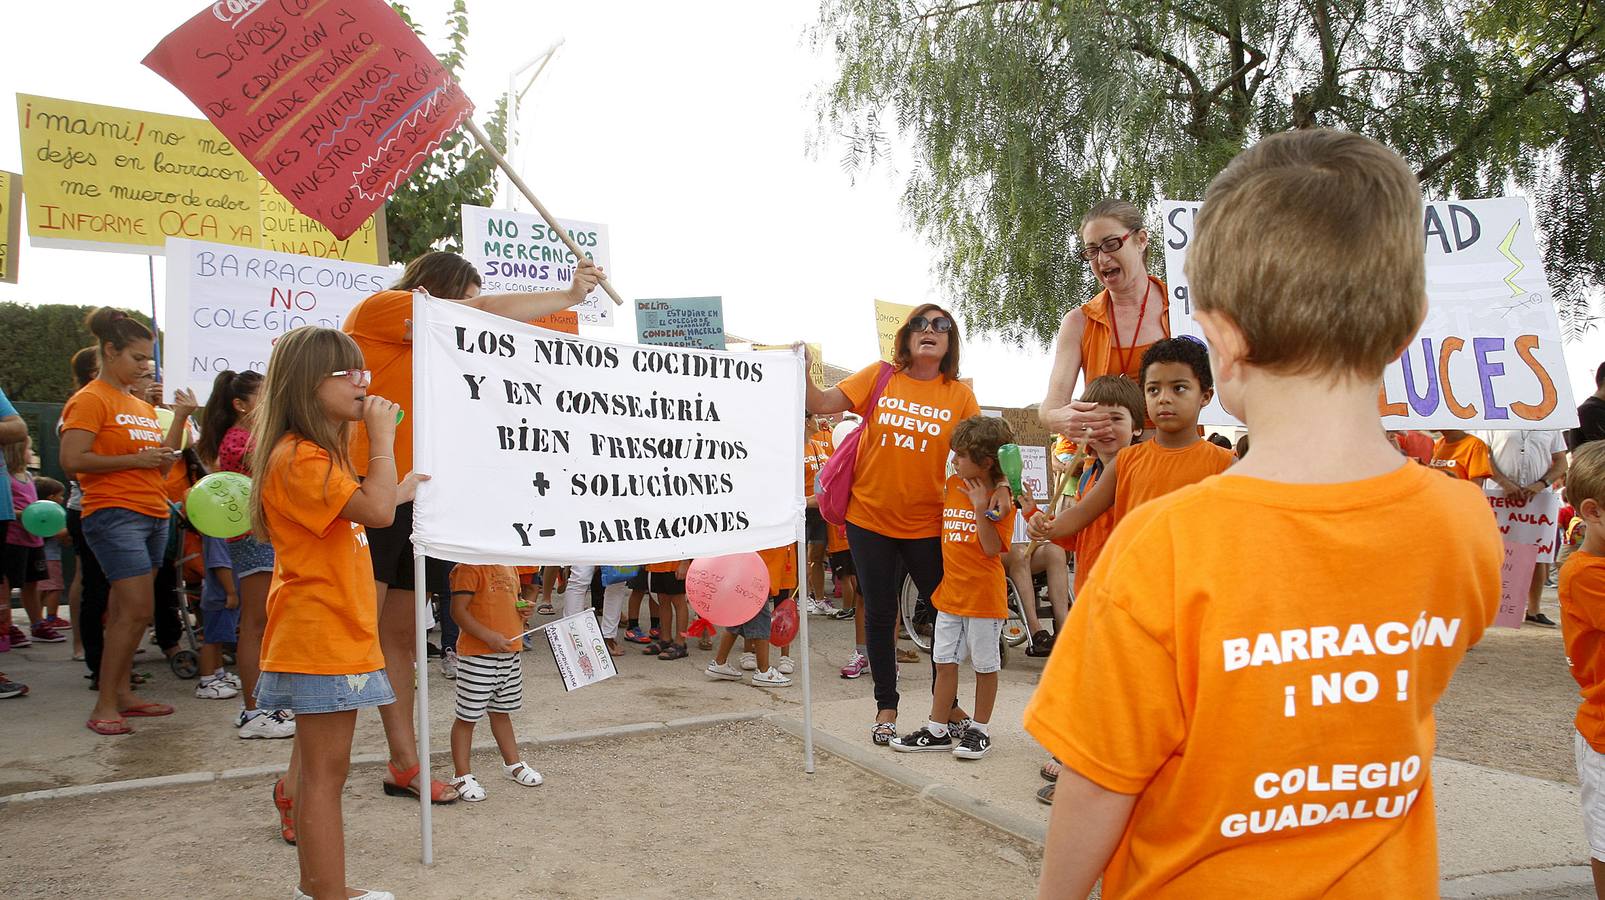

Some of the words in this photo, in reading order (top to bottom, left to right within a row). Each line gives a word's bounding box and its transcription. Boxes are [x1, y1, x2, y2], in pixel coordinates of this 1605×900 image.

[206, 97, 238, 118] DE
[242, 22, 328, 100] EDUCACIÓN
[336, 8, 357, 35] Y
[238, 89, 308, 149] ALCALDE
[303, 31, 374, 92] PEDÁNEO
[266, 148, 301, 176] LES
[300, 63, 392, 147] INVITAMOS
[393, 47, 412, 62] A
[148, 128, 185, 146] no
[199, 137, 234, 156] me
[36, 139, 98, 170] dejes
[114, 156, 146, 171] en
[153, 151, 249, 183] barracon
[291, 138, 361, 200] NUESTRO
[330, 190, 356, 220] CON
[360, 145, 405, 191] CORTES
[404, 126, 426, 144] DE
[61, 180, 101, 198] me
[109, 184, 182, 204] muero
[181, 188, 202, 207] de
[205, 195, 250, 211] calor
[39, 204, 147, 236] INFORME
[159, 210, 218, 238] OCA
[229, 224, 253, 243] YA
[263, 217, 297, 232] QUE
[488, 218, 519, 239] NO
[196, 251, 385, 293] BARRACONES
[484, 261, 550, 280] SOMOS
[270, 287, 317, 311] NO
[192, 356, 230, 372] NO
[455, 326, 516, 358] LOS
[534, 338, 620, 370] NIÑOS
[632, 348, 764, 383] COCIDITOS
[463, 374, 487, 400] Y
[502, 379, 545, 406] EN
[877, 412, 941, 437] NUEVO
[878, 396, 952, 421] COLEGIO
[497, 417, 571, 454] BIEN
[590, 432, 749, 460] FRESQUITOS
[893, 432, 915, 450] YA
[532, 471, 551, 496] +
[571, 466, 734, 497] SOLUCIONES
[579, 511, 750, 544] BARRACONES
[943, 520, 977, 533] NUEVO
[1508, 513, 1554, 526] AULA
[1223, 611, 1462, 672] BARRACÓN
[1311, 671, 1379, 706] NO
[1254, 755, 1421, 799] COLEGIO
